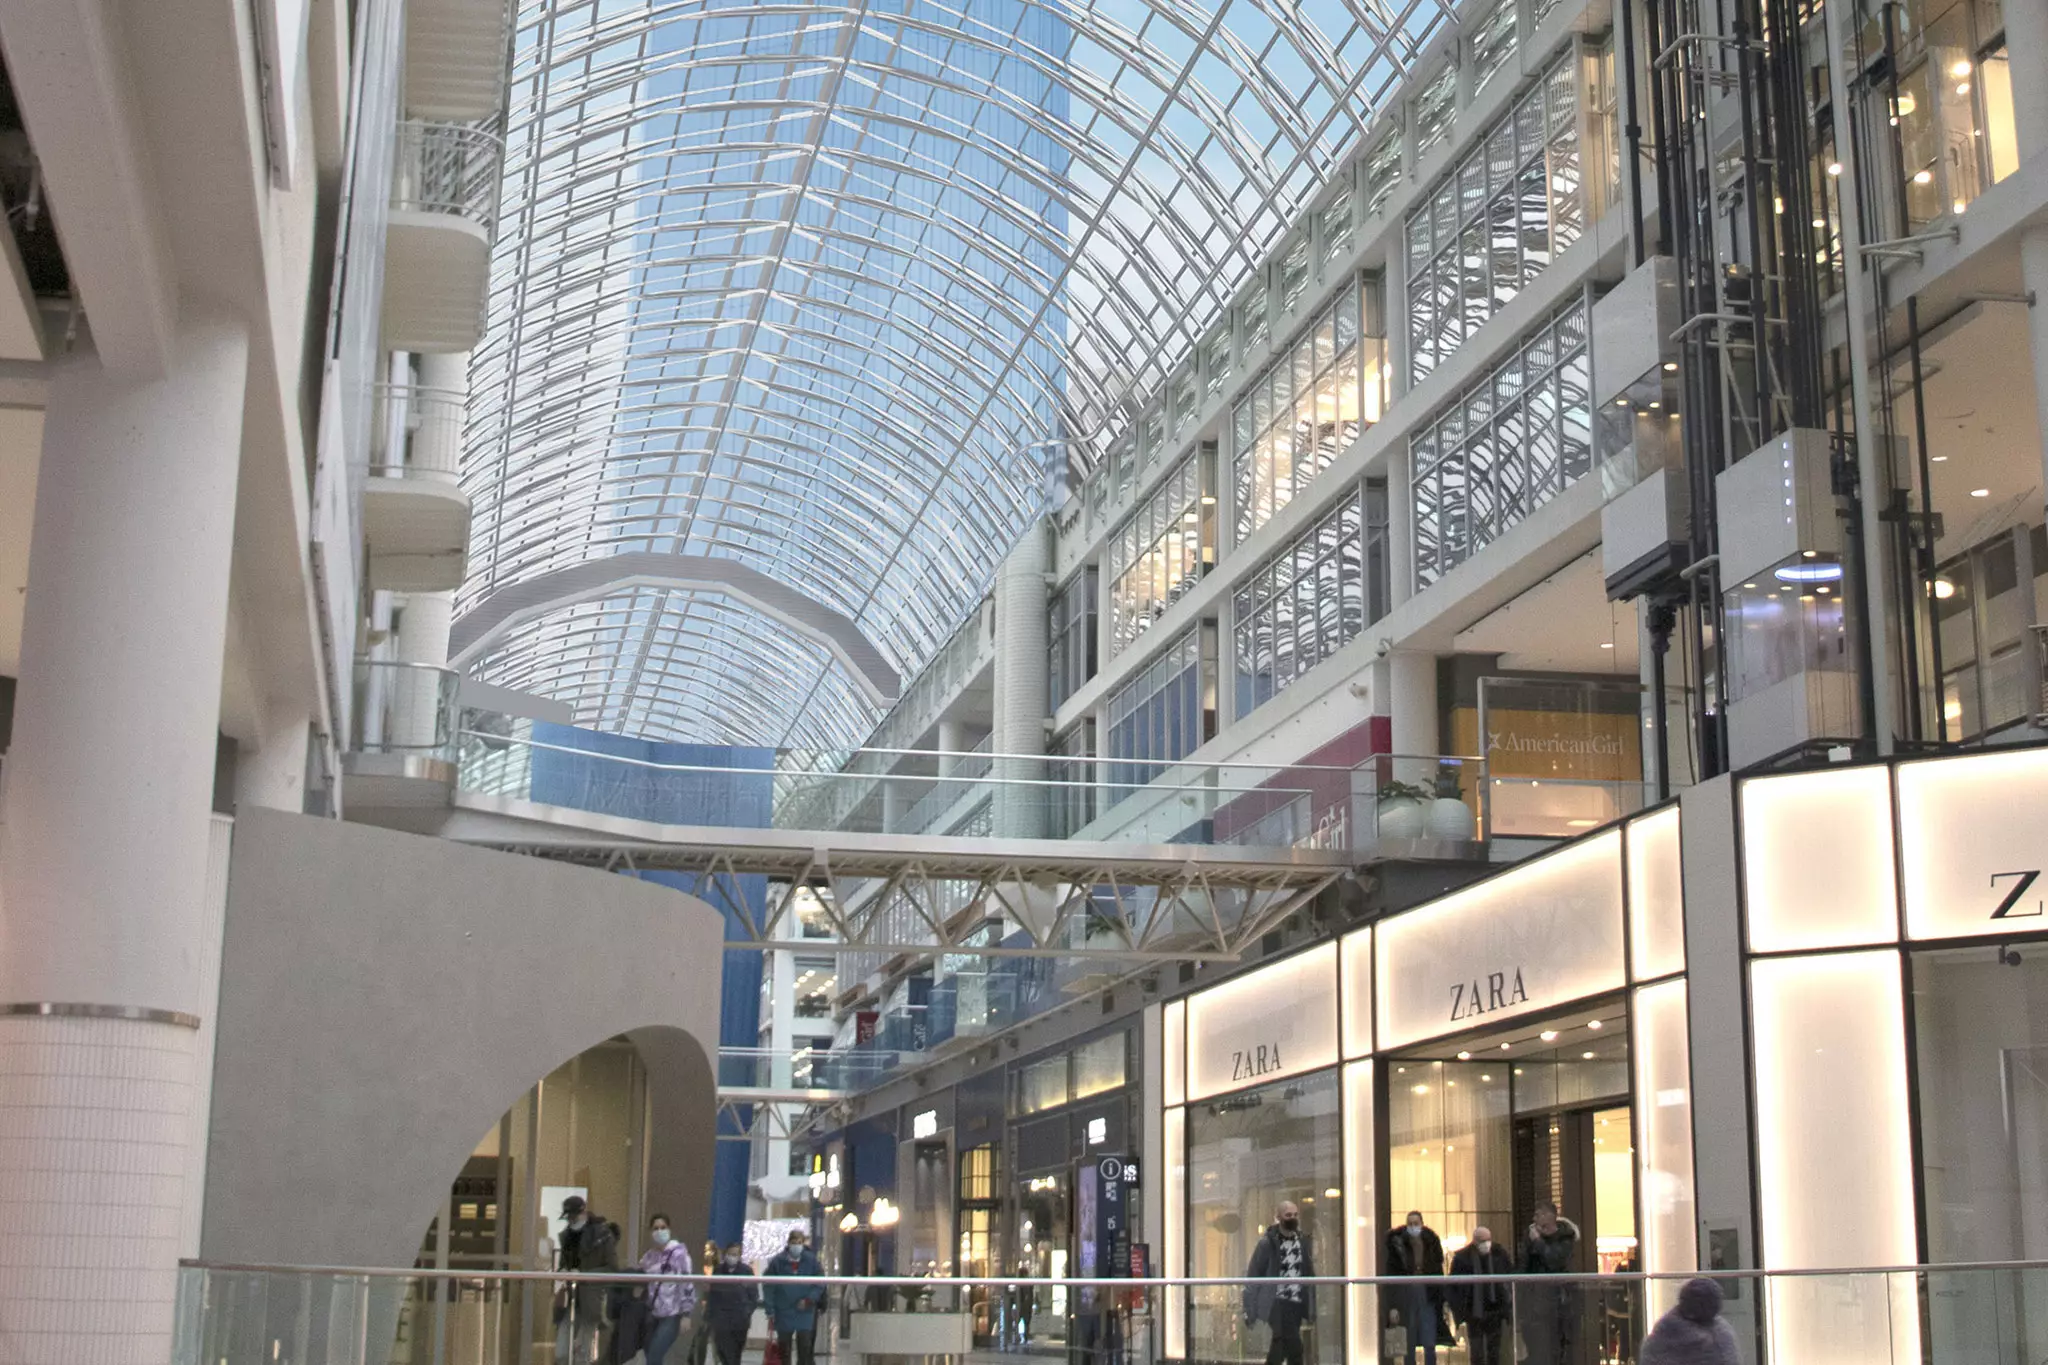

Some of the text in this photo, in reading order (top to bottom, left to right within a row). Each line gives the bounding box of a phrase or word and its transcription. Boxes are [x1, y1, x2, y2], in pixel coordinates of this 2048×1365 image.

[1990, 869, 2043, 919] Z
[1449, 966, 1529, 1022] ZARA
[1232, 1042, 1283, 1081] ZARA
